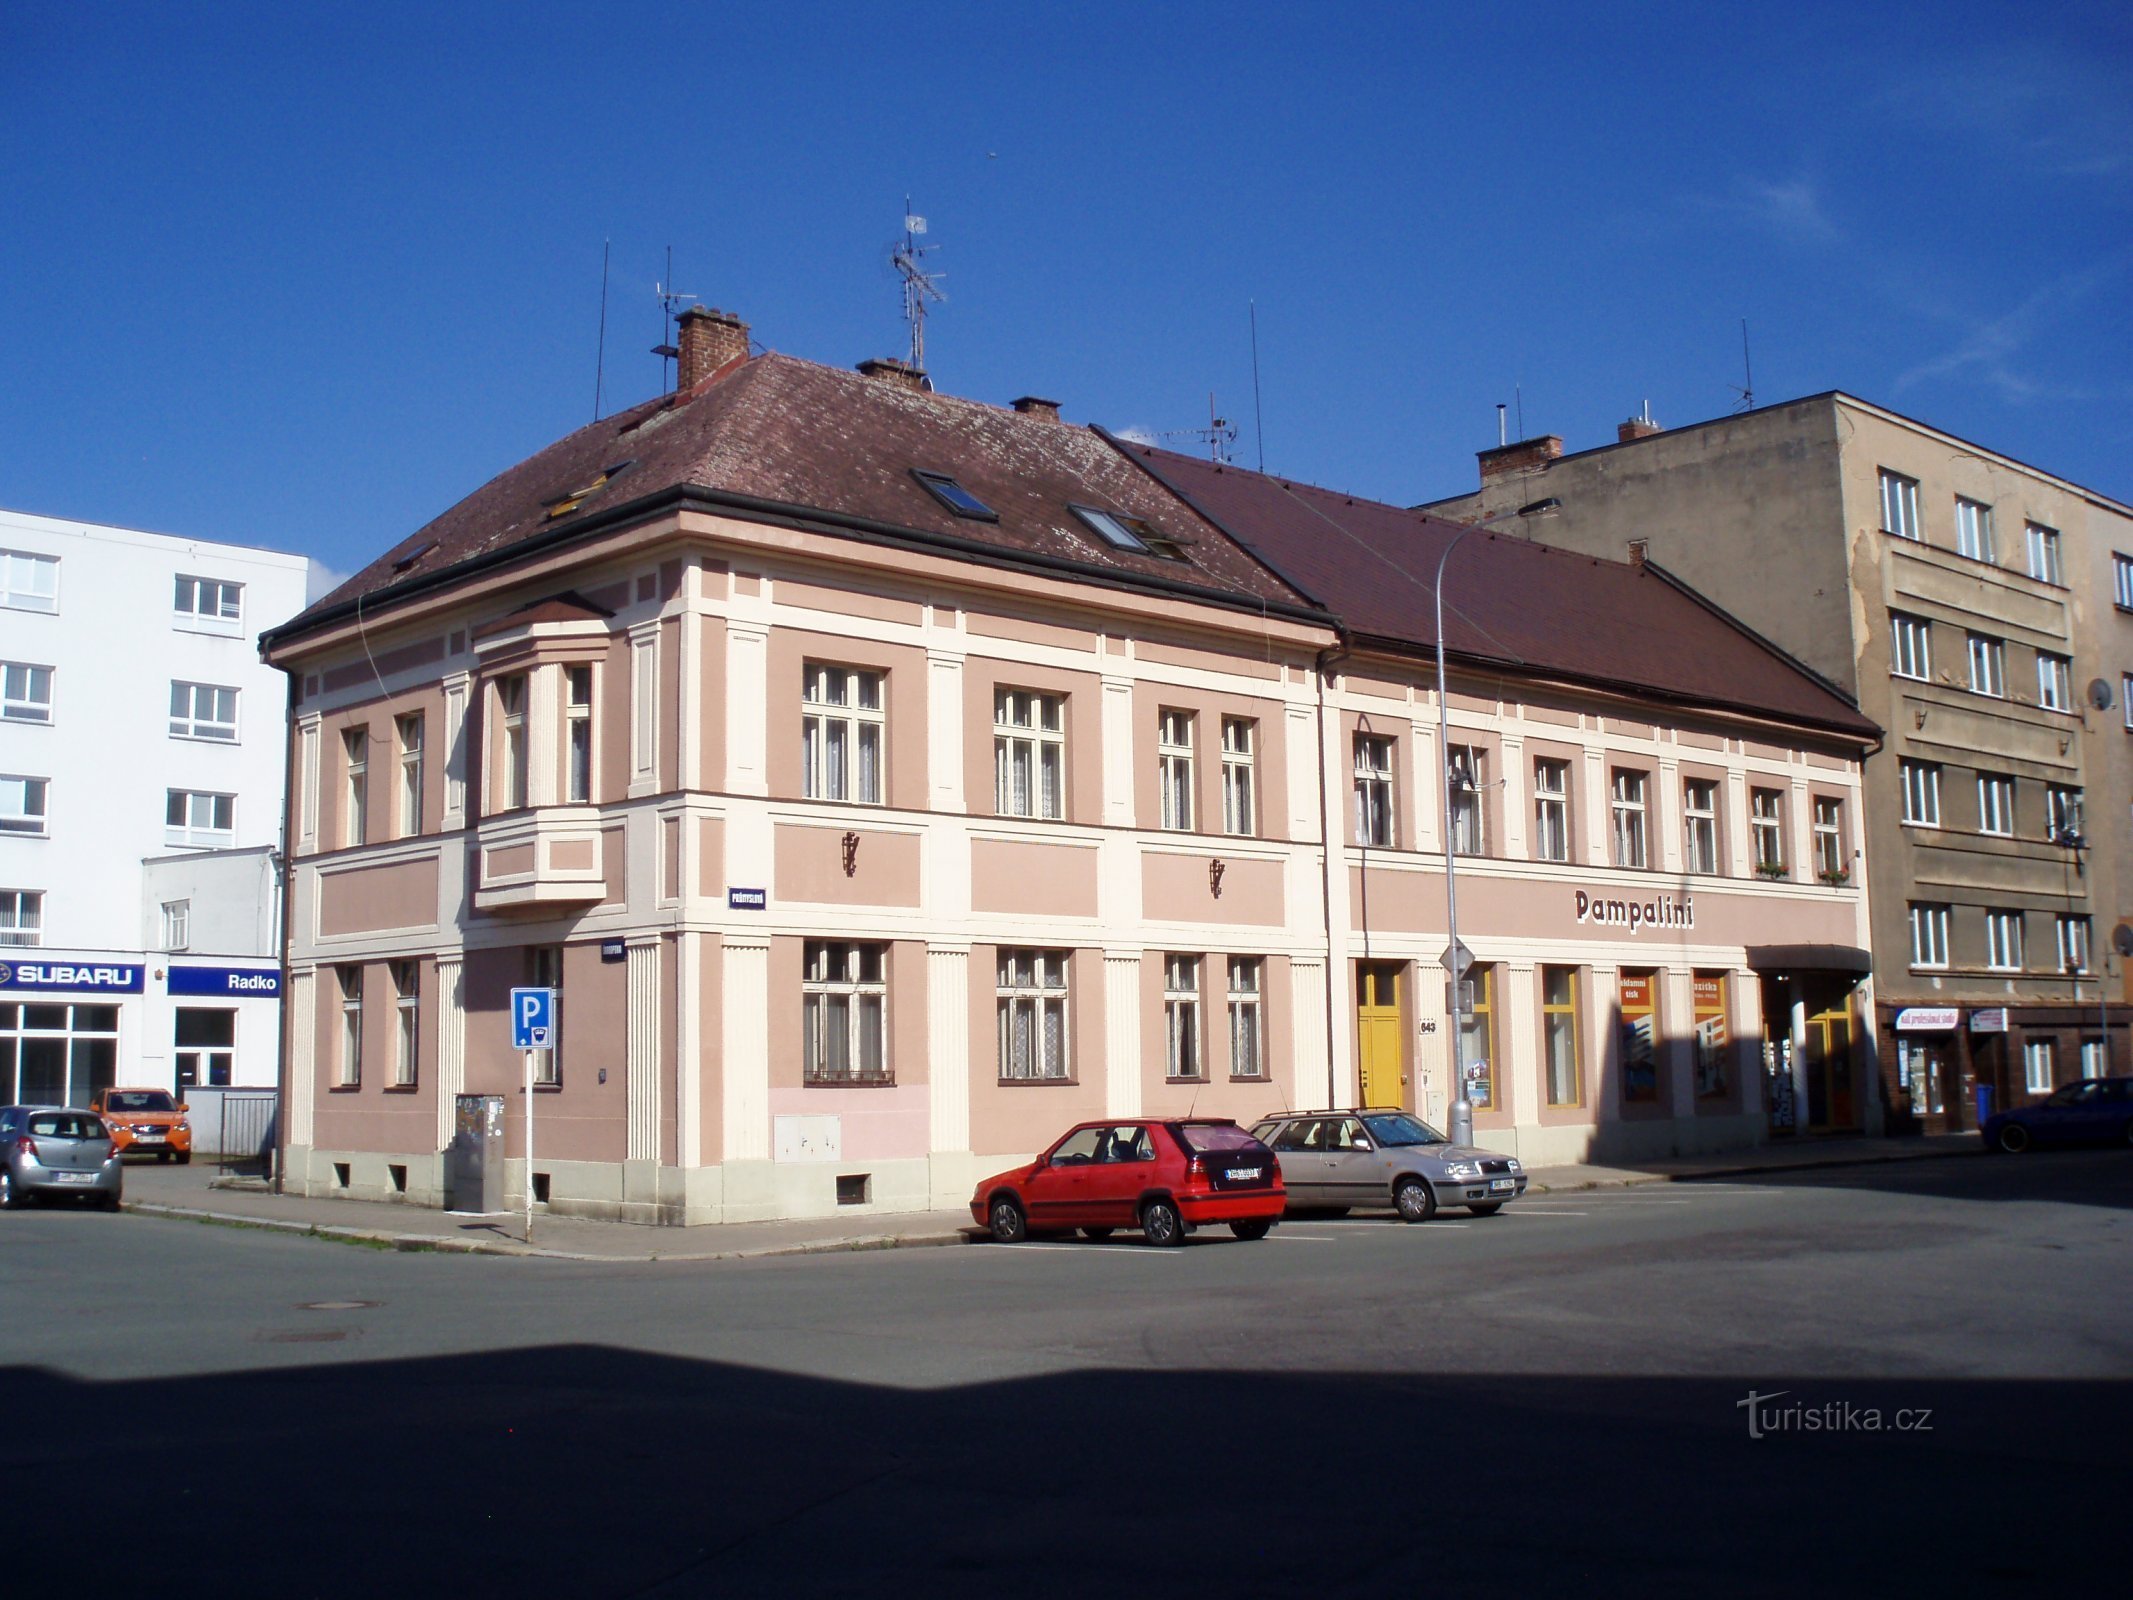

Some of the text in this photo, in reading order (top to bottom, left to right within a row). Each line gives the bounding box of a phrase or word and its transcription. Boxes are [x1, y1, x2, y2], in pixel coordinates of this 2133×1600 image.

[1575, 889, 1694, 935] Pampalini
[17, 966, 132, 985] SUBARU
[228, 974, 277, 990] Radko
[523, 996, 540, 1028] P
[1421, 1022, 1436, 1032] 643
